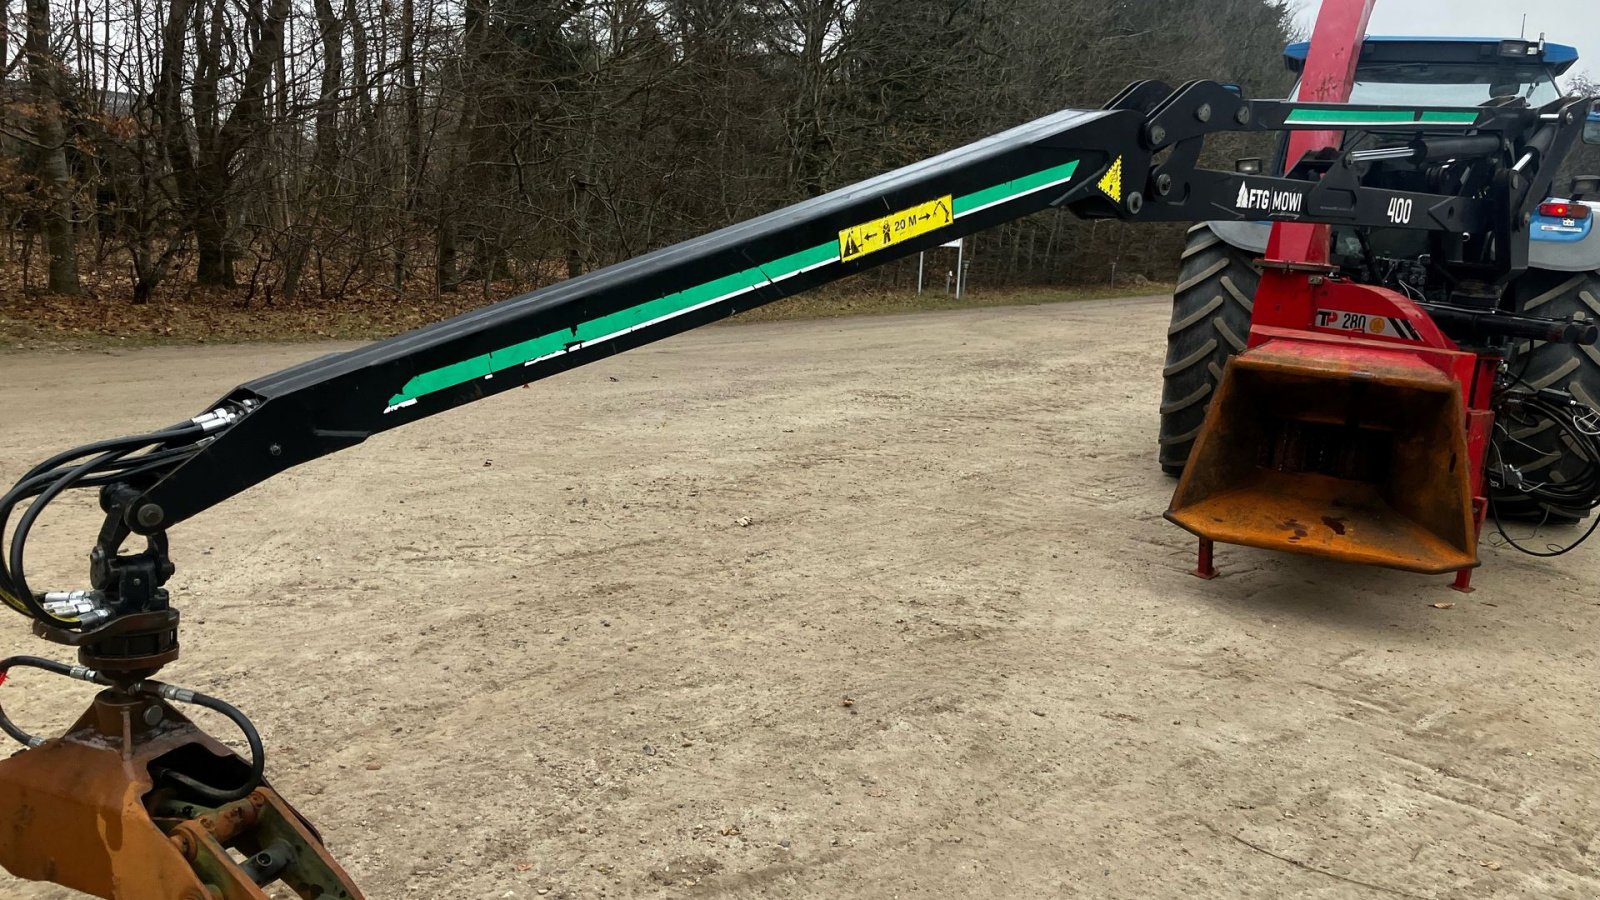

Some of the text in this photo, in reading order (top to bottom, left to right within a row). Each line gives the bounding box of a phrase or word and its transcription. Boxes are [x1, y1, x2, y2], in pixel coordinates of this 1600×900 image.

[1248, 189, 1302, 211] FTG MOWI
[1387, 197, 1412, 224] 400
[894, 215, 917, 232] 20 M
[1318, 311, 1366, 328] TP 280
